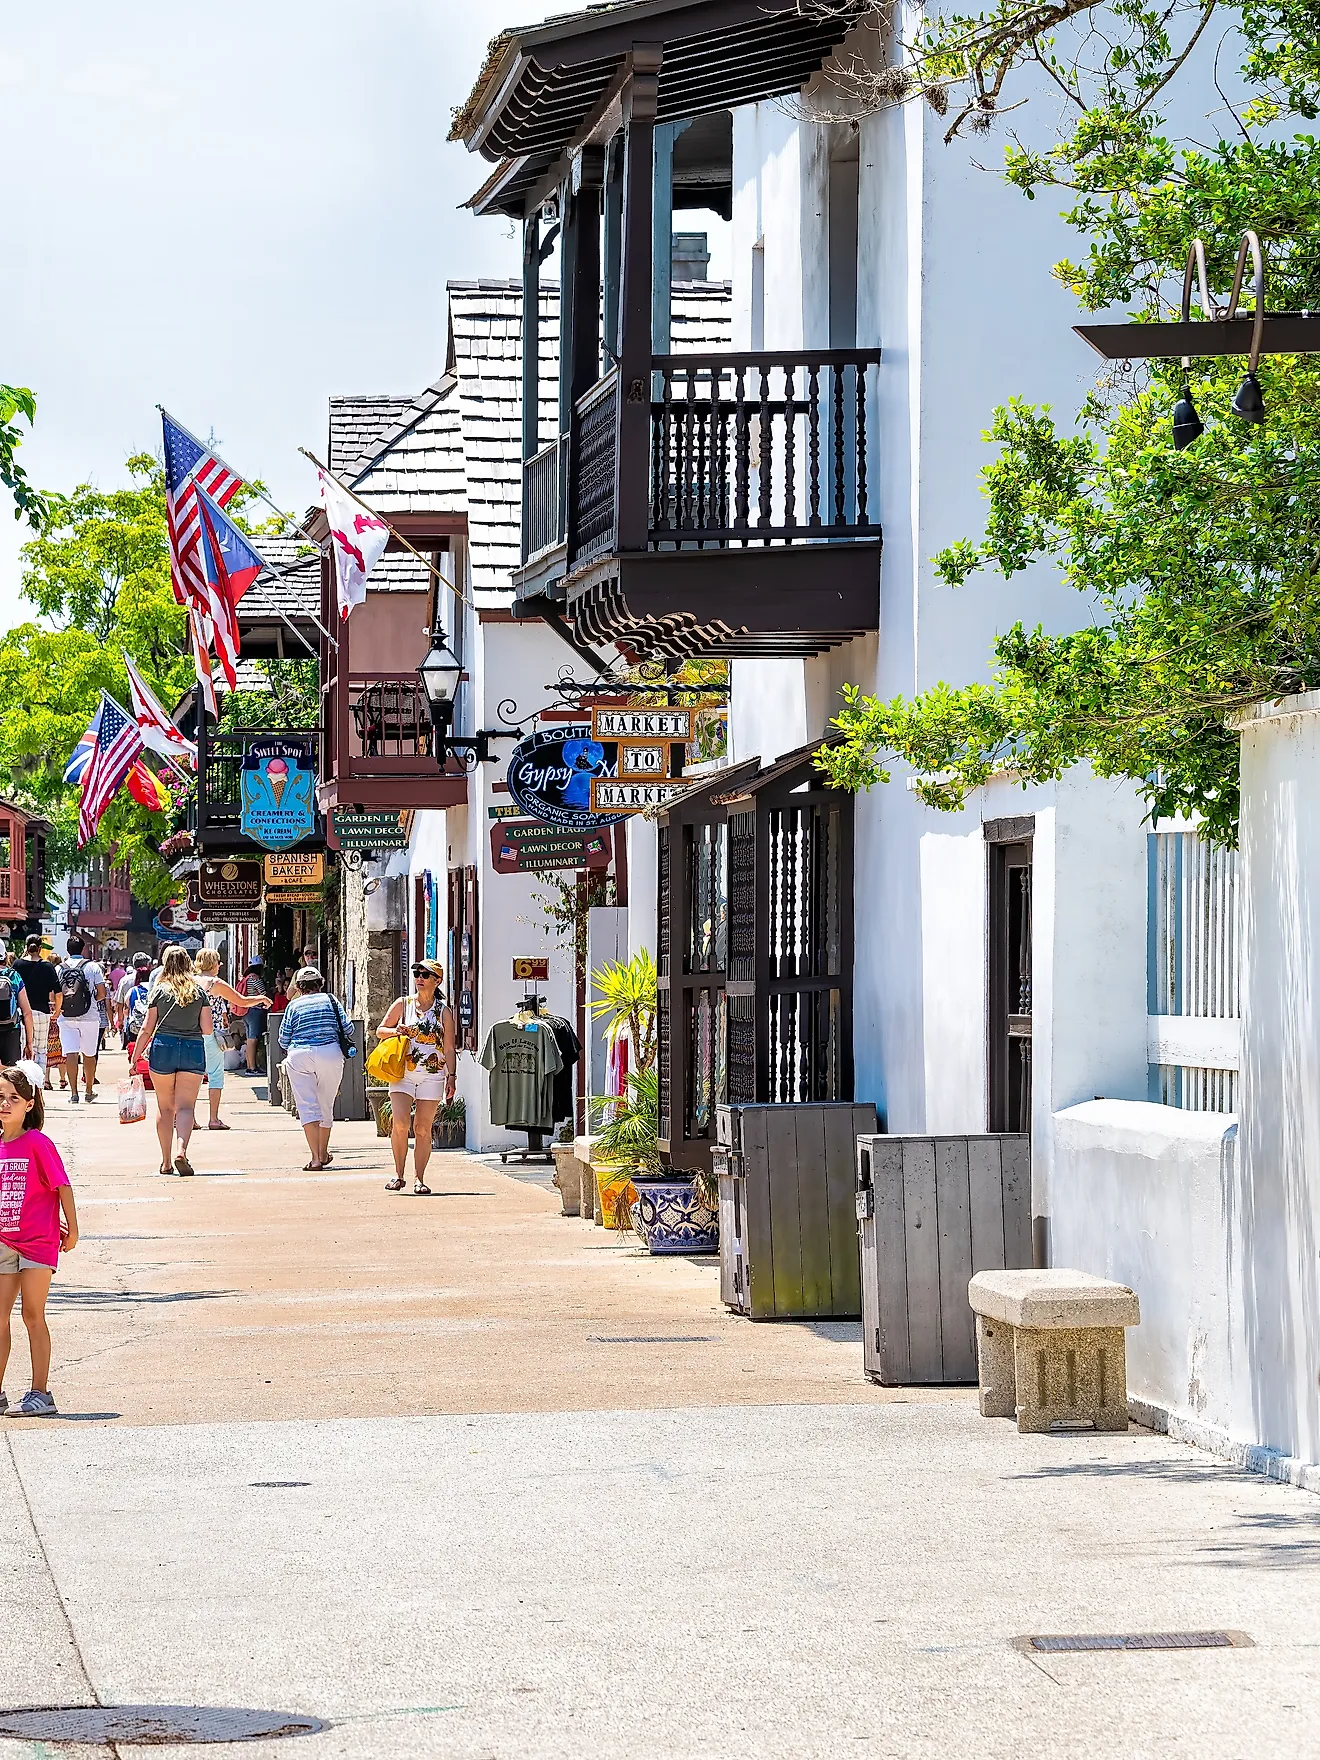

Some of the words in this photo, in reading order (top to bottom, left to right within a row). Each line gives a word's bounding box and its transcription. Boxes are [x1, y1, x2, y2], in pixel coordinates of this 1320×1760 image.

[604, 716, 682, 732] MARKET
[541, 727, 591, 743] BOUTI
[281, 744, 303, 759] SPOT
[631, 752, 655, 767] TO
[518, 762, 573, 792] Gypsy
[603, 788, 676, 803] MARKE
[495, 806, 520, 816] THE
[524, 793, 569, 819] ORGANIC
[337, 815, 380, 823] GARDEN
[527, 803, 549, 818] HAND
[549, 816, 574, 826] MADE
[513, 827, 555, 838] GARDEN
[522, 843, 548, 854] LAWN
[549, 842, 581, 852] DECOR
[269, 853, 318, 863] SPANISH
[525, 857, 579, 868] ILLUMINART
[272, 865, 315, 876] BAKERY
[204, 881, 258, 890] WHETSTONE
